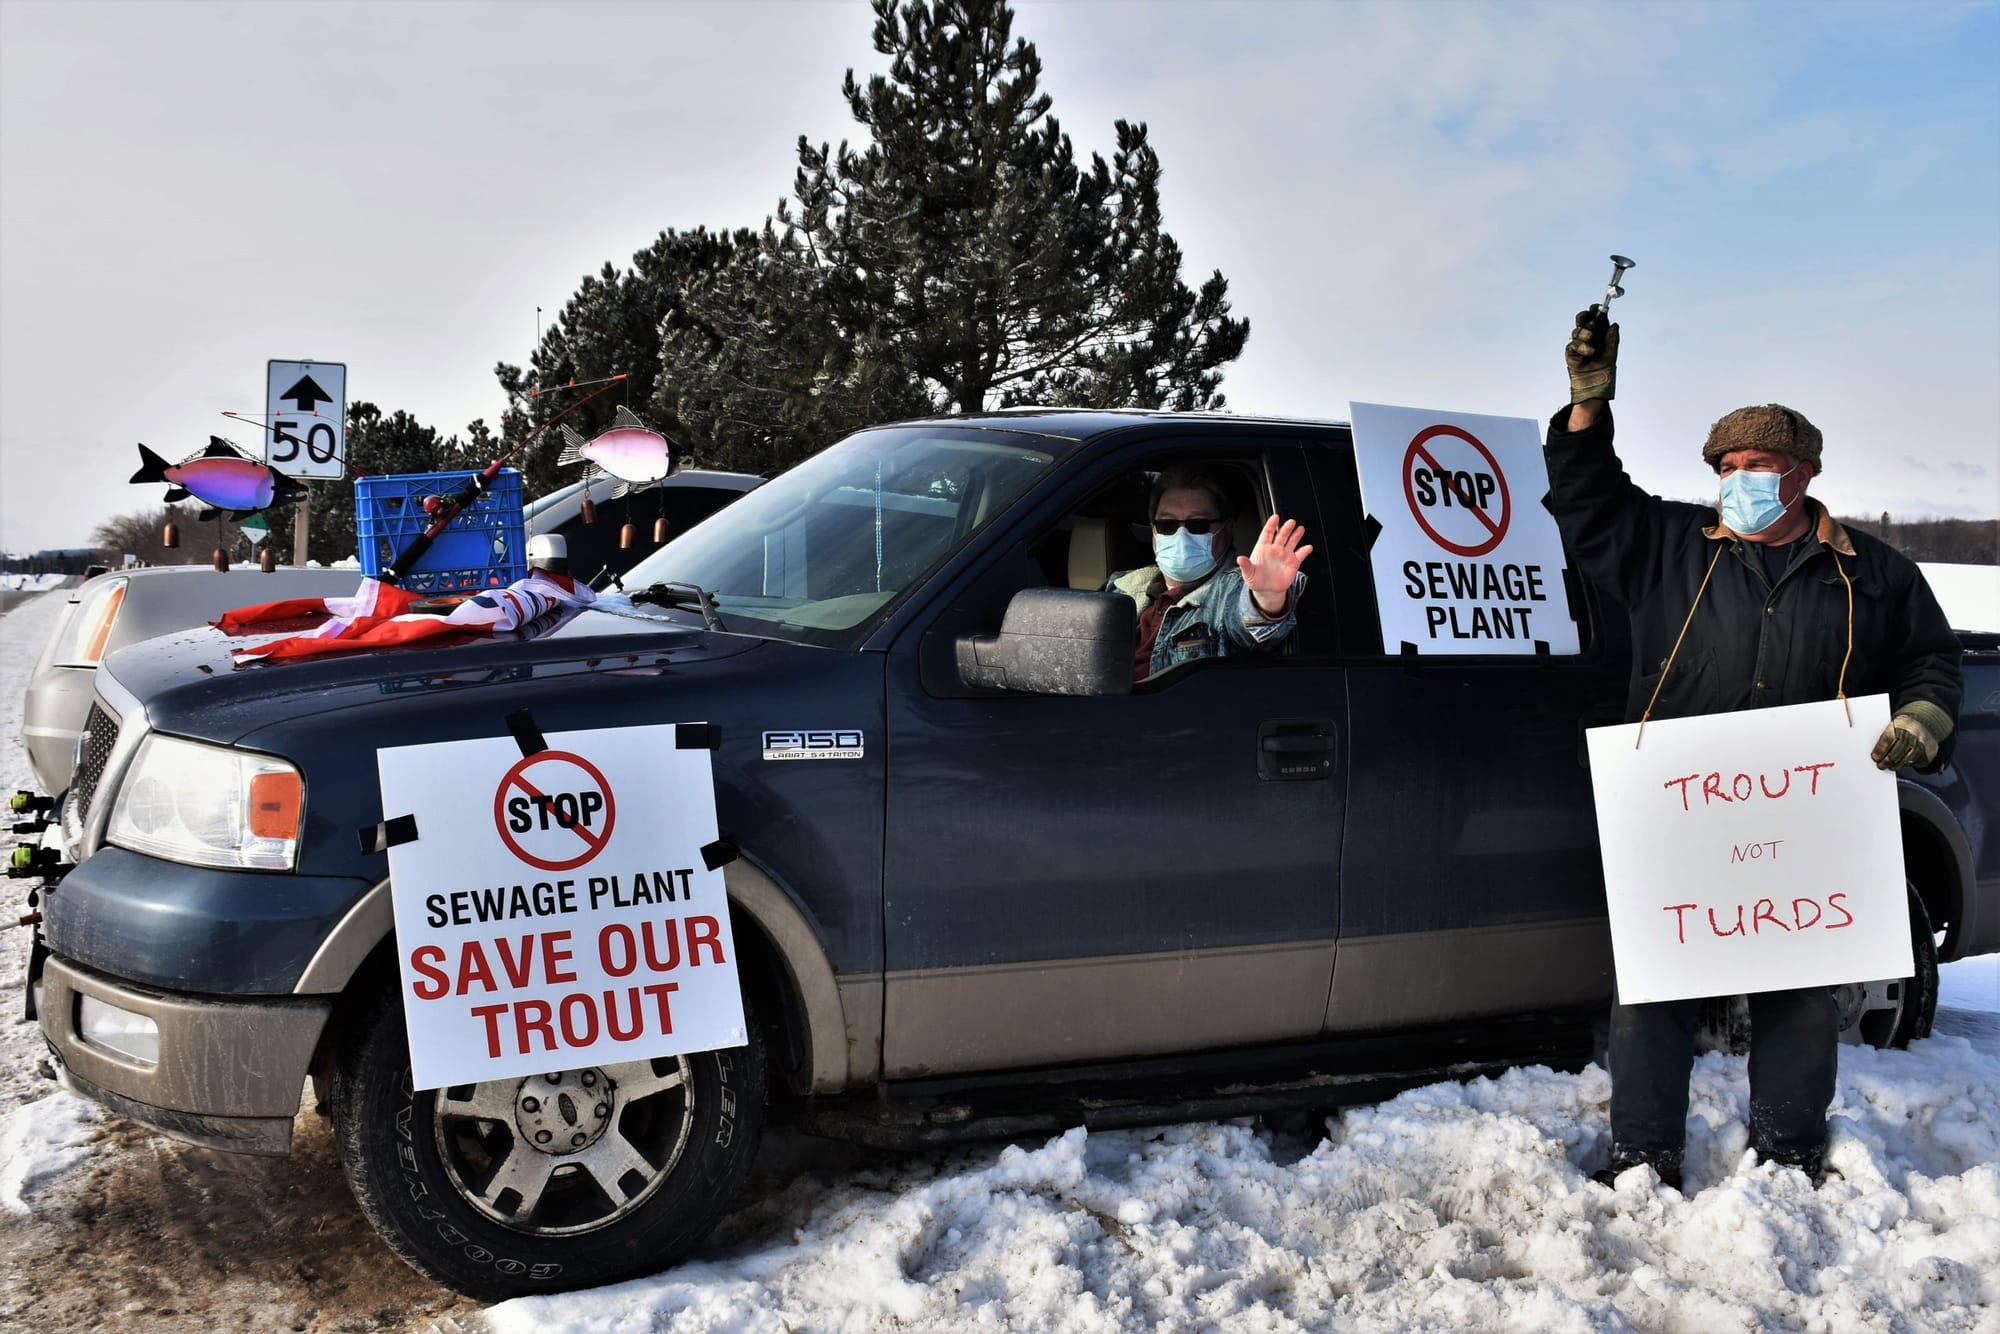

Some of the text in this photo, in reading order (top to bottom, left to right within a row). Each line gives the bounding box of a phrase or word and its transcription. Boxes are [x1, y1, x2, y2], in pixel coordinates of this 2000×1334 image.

[272, 421, 336, 464] 50
[1415, 466, 1497, 511] STOP
[1403, 560, 1547, 602] SEWAGE
[1426, 606, 1533, 640] PLANT
[765, 732, 861, 749] F-150
[1664, 763, 1835, 811] TROUT
[509, 791, 603, 834] STOP
[1730, 840, 1785, 864] NOT
[427, 868, 694, 929] SEWAGE PLANT
[1663, 893, 1853, 944] TURDS
[411, 915, 726, 1001] SAVE OUR
[470, 982, 680, 1059] TROUT
